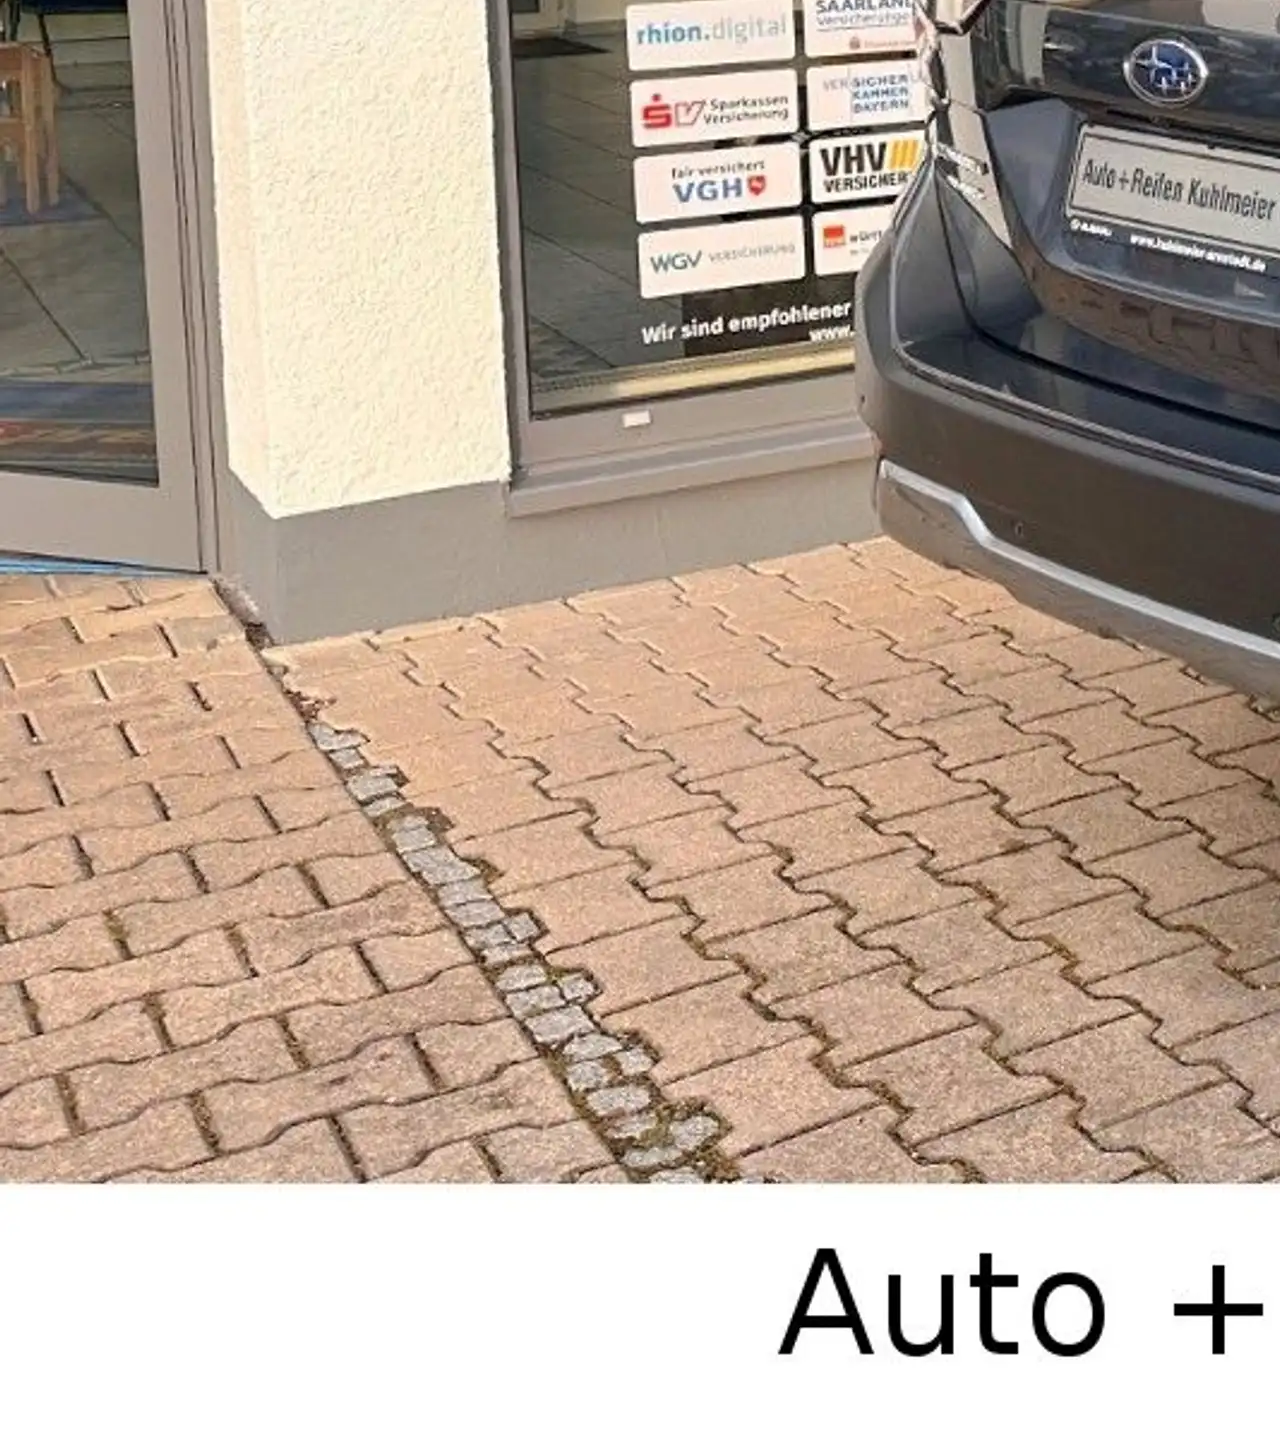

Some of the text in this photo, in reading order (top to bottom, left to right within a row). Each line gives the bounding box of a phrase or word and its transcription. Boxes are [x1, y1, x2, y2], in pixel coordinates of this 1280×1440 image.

[637, 13, 786, 44] rhion.digital
[710, 95, 788, 111] Sparkassen
[704, 109, 788, 125] Versicherung
[672, 160, 765, 179] fair versichert
[820, 142, 886, 176] VHV
[673, 177, 742, 202] VGH
[1188, 177, 1276, 221] Kuhlmeier
[650, 250, 702, 272] WGV
[641, 301, 851, 344] Wir sind empfohlener
